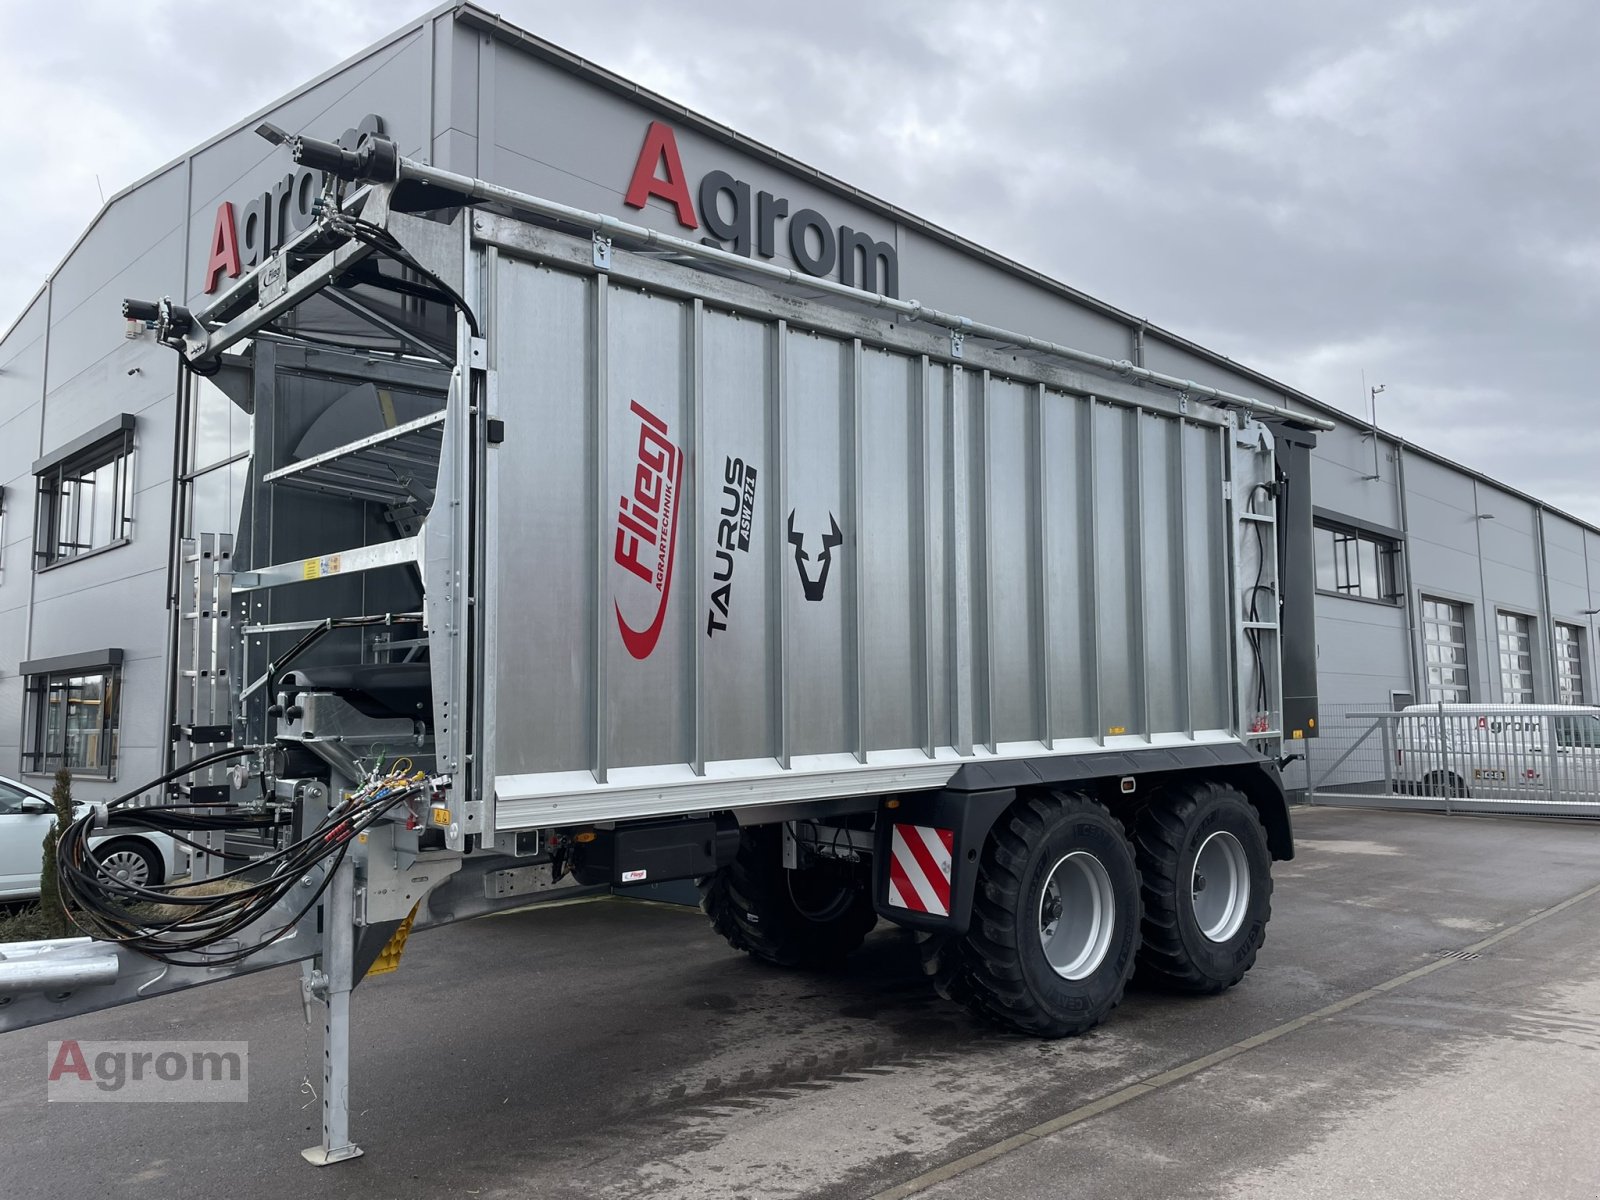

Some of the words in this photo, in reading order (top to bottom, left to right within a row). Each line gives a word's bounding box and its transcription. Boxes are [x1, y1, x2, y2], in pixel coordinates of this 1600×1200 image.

[624, 121, 899, 299] Agrom
[614, 399, 676, 584] Fliegl
[655, 483, 672, 593] AGRARTECHNIK
[740, 504, 752, 541] ASW
[744, 477, 755, 503] 271
[707, 455, 744, 639] TAURUS
[1475, 716, 1541, 733] Agrom
